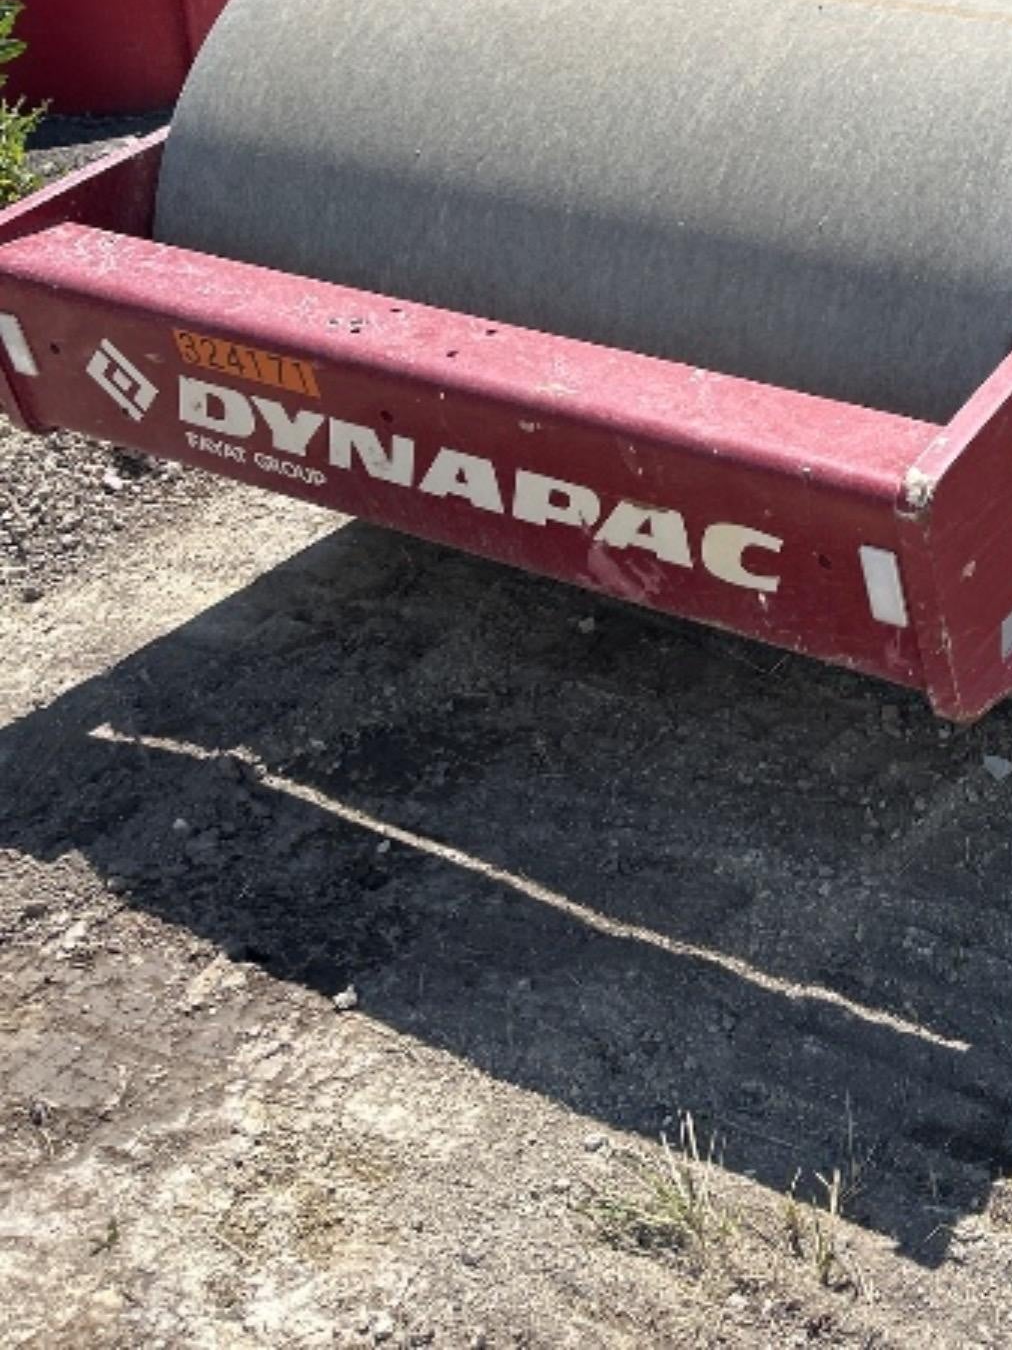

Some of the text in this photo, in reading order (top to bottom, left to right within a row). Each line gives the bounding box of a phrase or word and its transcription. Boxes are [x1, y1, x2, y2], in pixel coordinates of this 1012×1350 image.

[178, 332, 311, 395] 324171
[178, 374, 784, 593] DYNAPAC
[253, 452, 328, 486] GROUP
